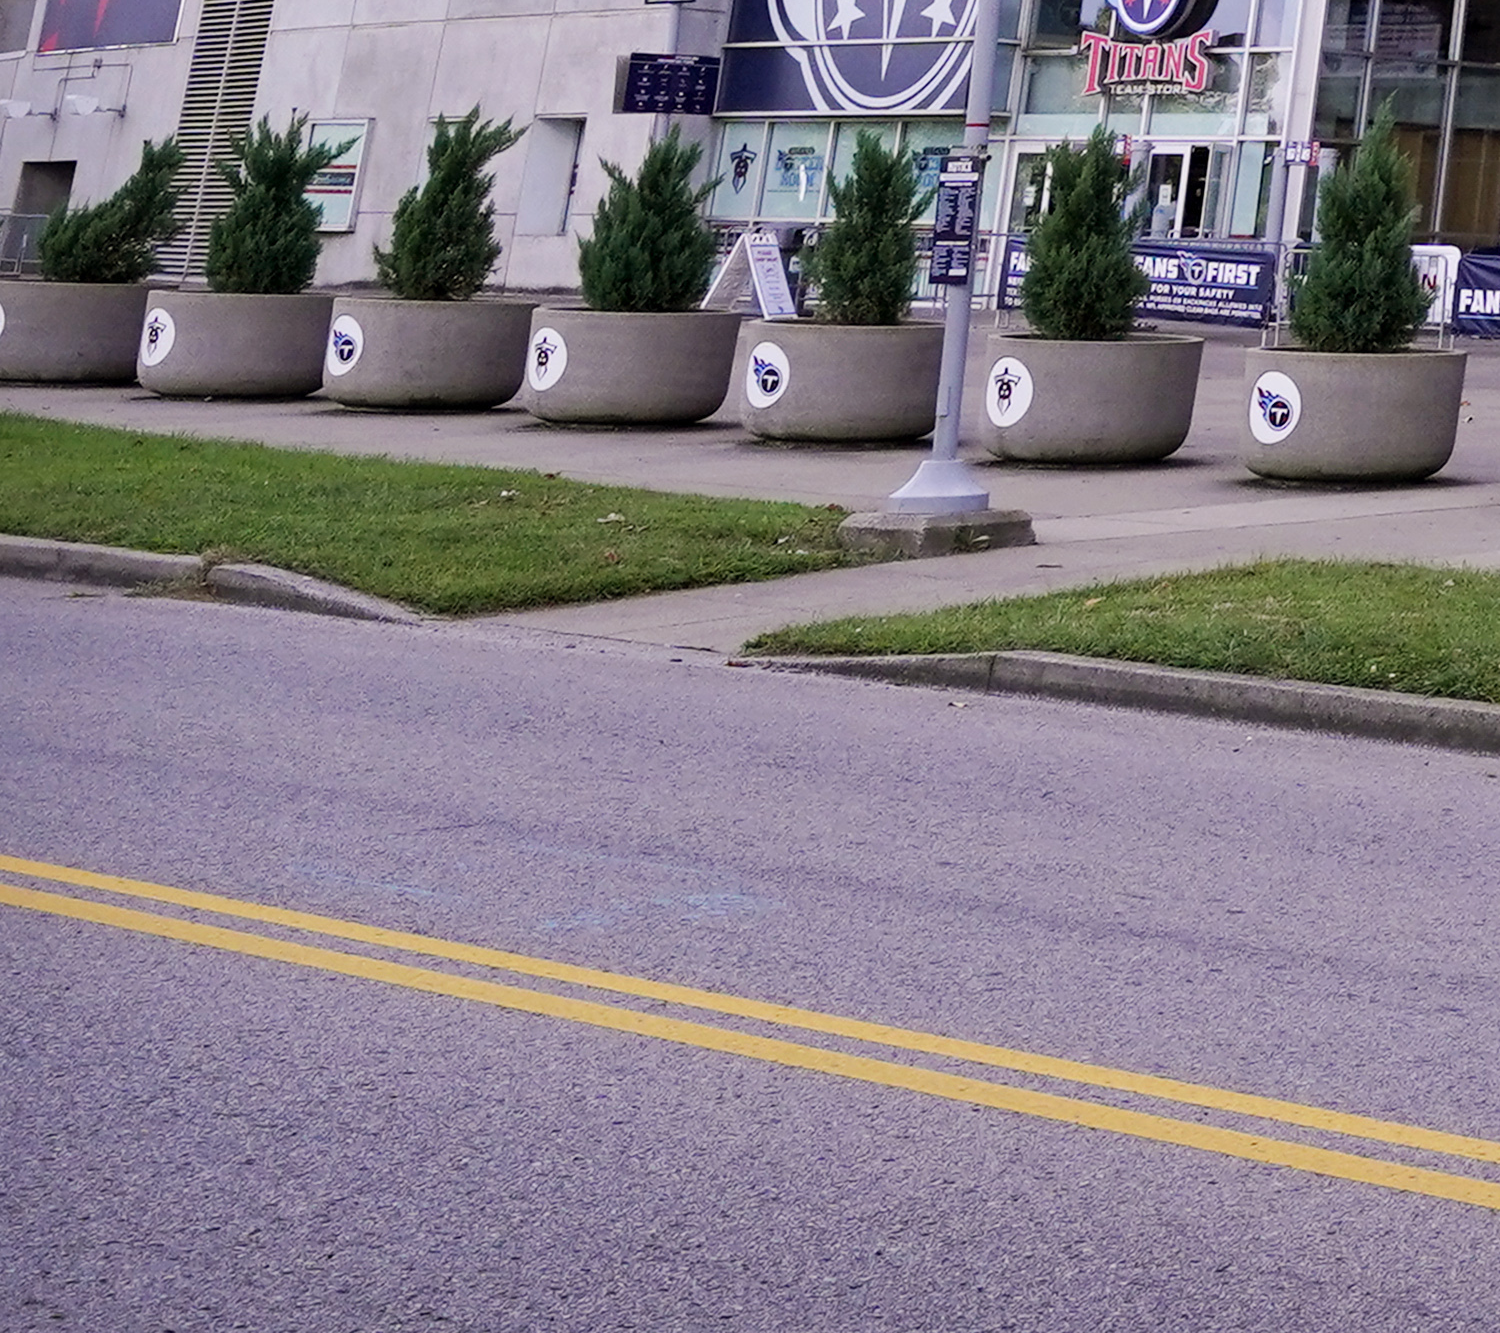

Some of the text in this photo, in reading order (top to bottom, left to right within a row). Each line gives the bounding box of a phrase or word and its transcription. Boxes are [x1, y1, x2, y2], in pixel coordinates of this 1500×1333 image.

[1081, 29, 1213, 96] TITANS
[1110, 84, 1189, 95] TEAM STORE
[1205, 262, 1261, 285] FIRST
[1151, 284, 1235, 299] FOR YOUR SAFETY
